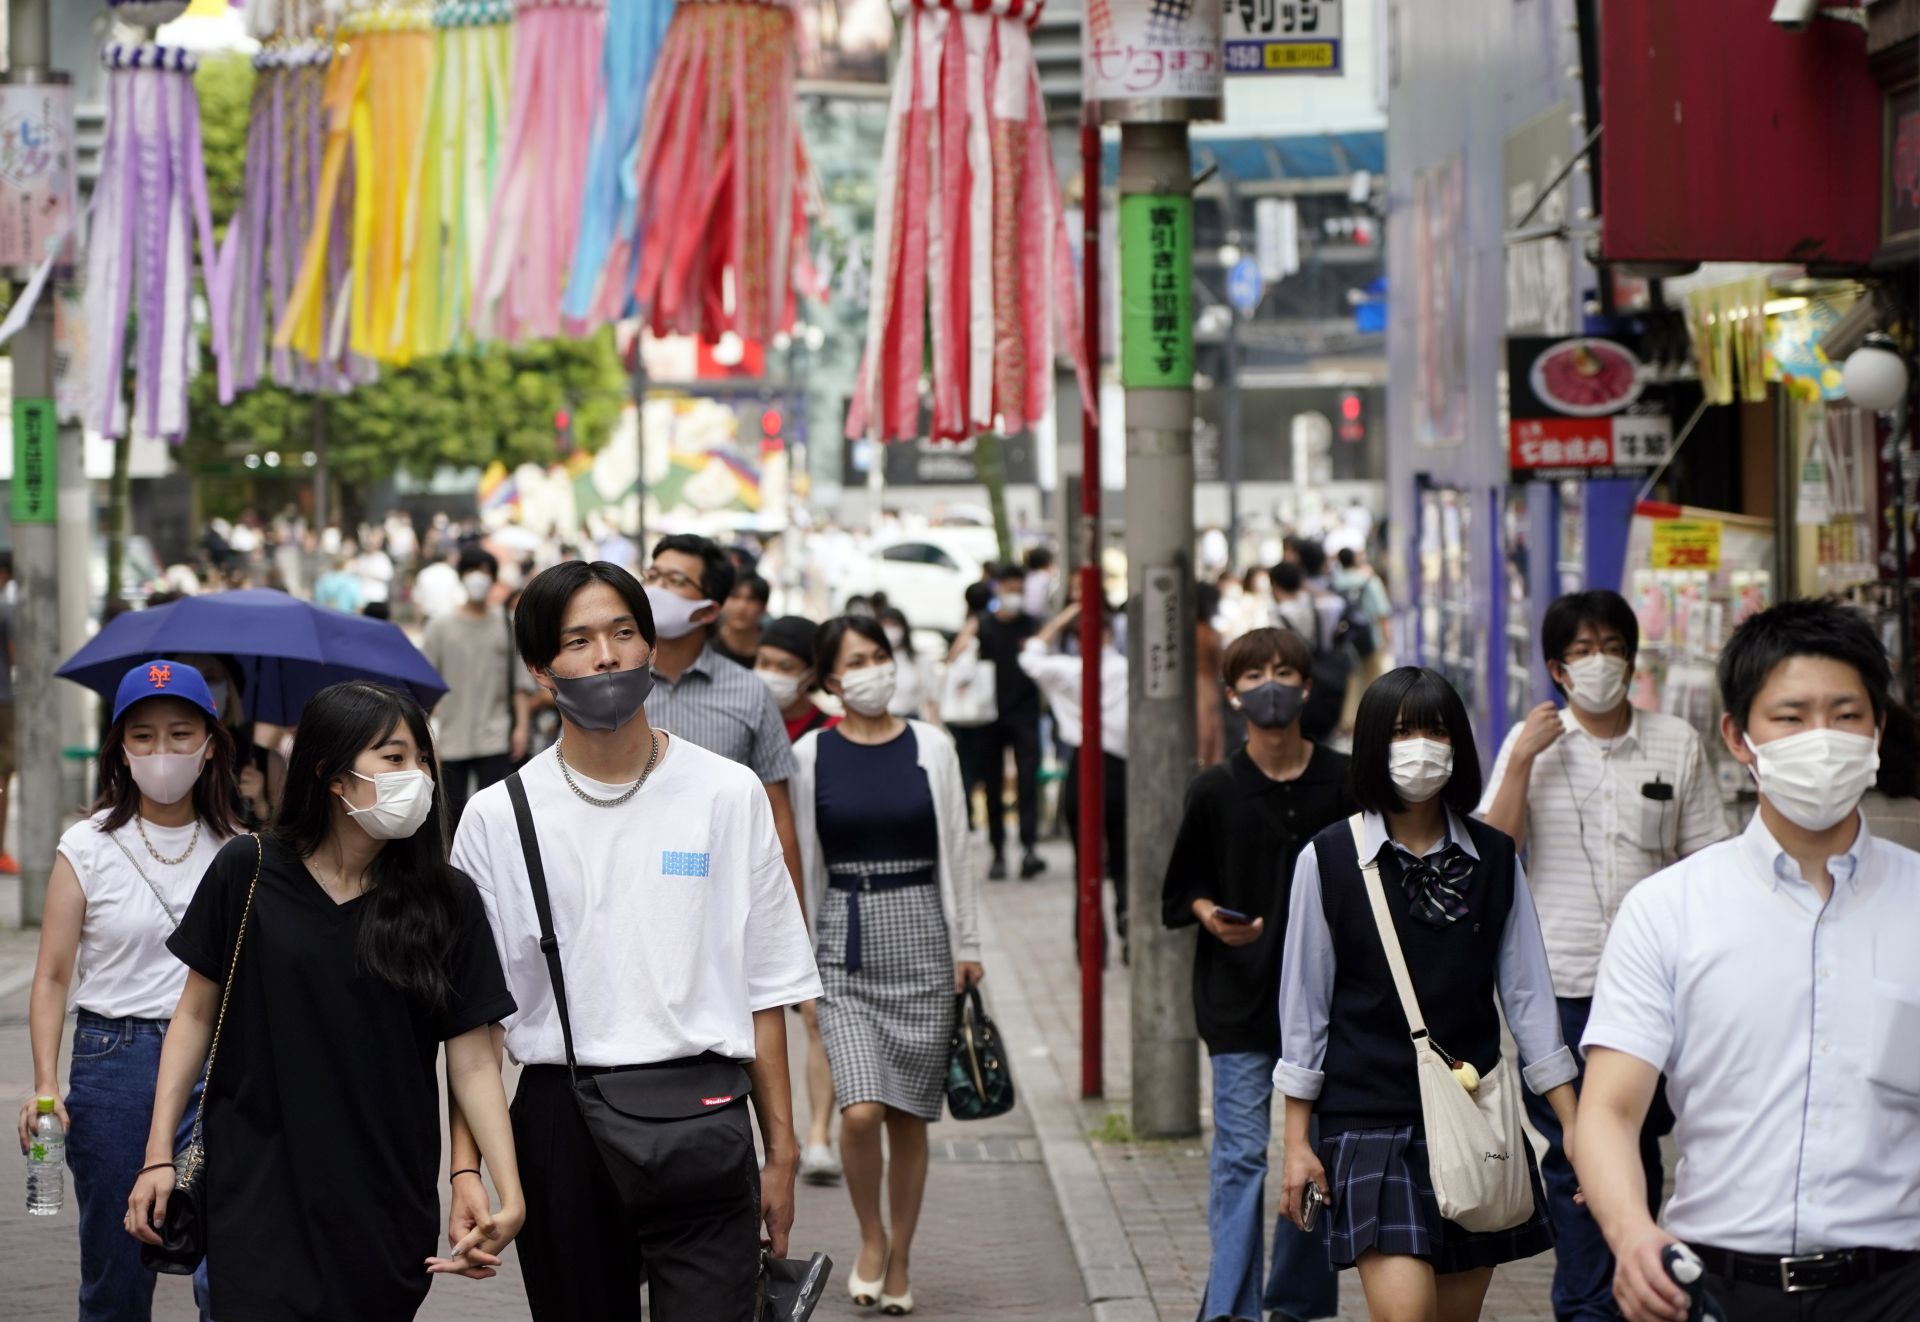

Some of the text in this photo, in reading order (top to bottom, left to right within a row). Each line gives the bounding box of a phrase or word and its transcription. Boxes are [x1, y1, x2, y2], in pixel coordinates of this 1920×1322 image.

[1151, 206, 1179, 373] 客引きは犯罪です
[149, 664, 171, 689] NY
